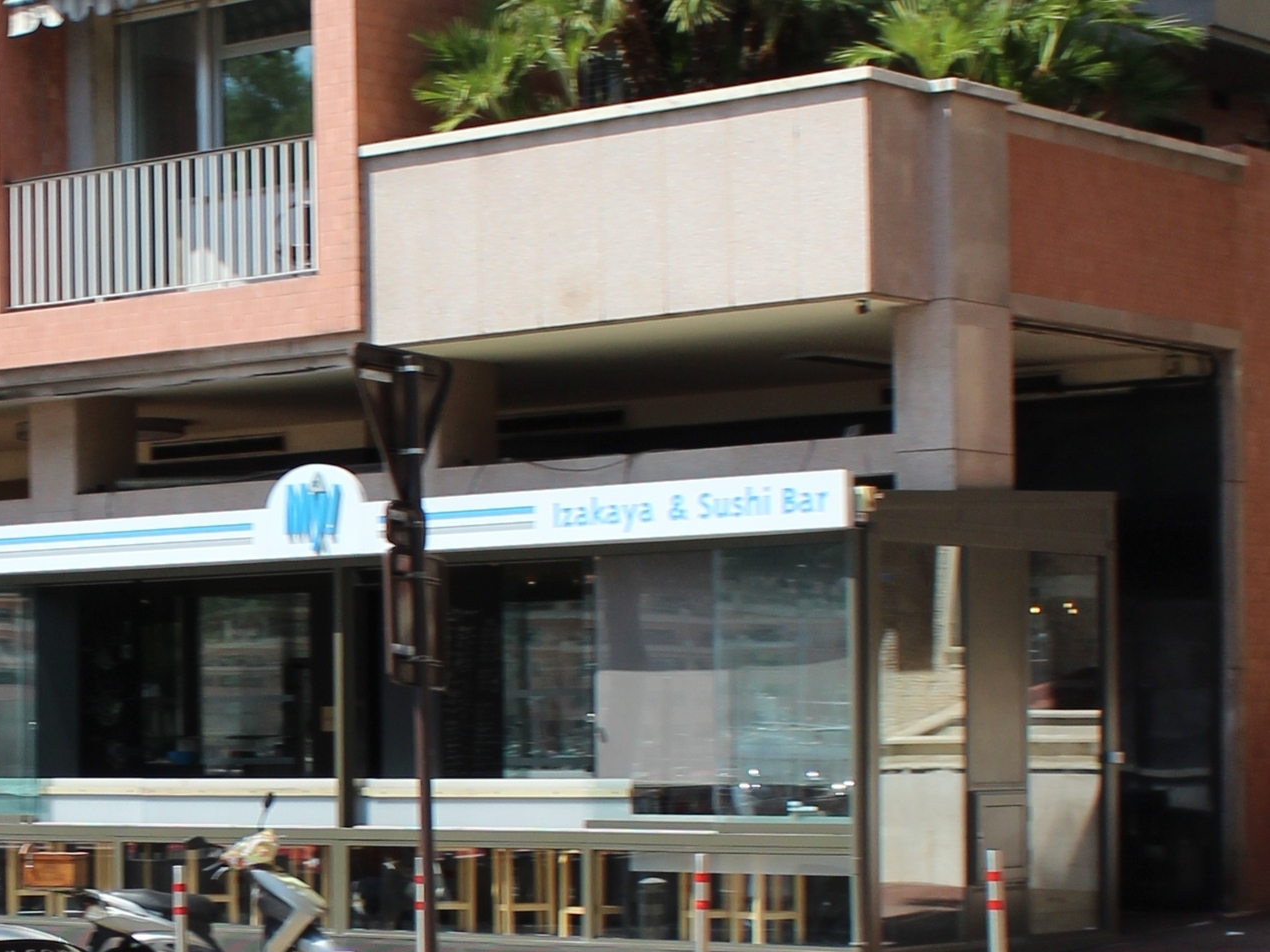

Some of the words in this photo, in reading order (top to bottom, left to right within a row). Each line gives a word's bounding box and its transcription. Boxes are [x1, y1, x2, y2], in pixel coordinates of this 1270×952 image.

[552, 497, 654, 532] Izakaya
[669, 493, 688, 521] &
[698, 486, 772, 519] Sushi
[780, 487, 830, 514] Bar
